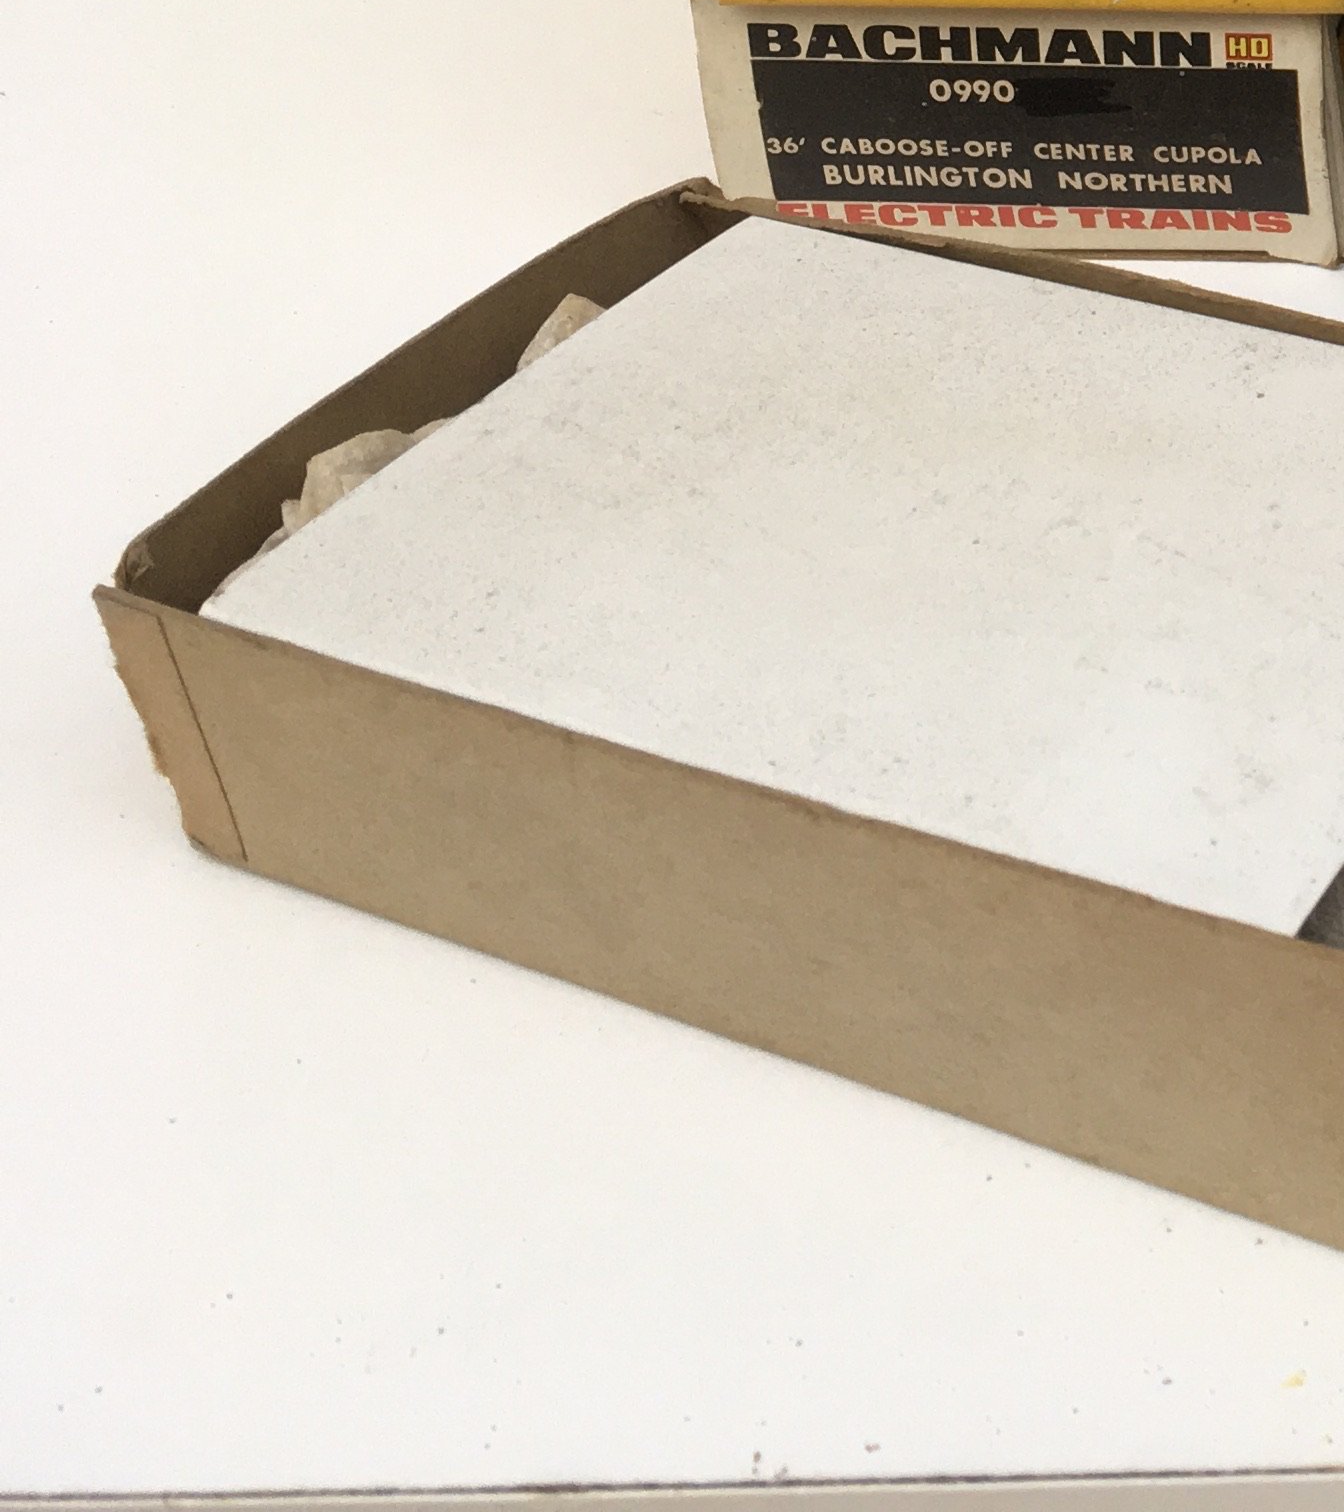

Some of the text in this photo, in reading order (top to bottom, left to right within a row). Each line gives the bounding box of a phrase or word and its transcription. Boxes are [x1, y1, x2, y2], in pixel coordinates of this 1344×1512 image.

[746, 22, 1212, 67] BACHMANN
[929, 79, 1015, 103] 0990
[821, 137, 1262, 166] CABOOSE-OFF CENTER CUPOLA
[822, 164, 1233, 195] BURLINGTON NORTHERN
[1068, 207, 1292, 234] TRAINS
